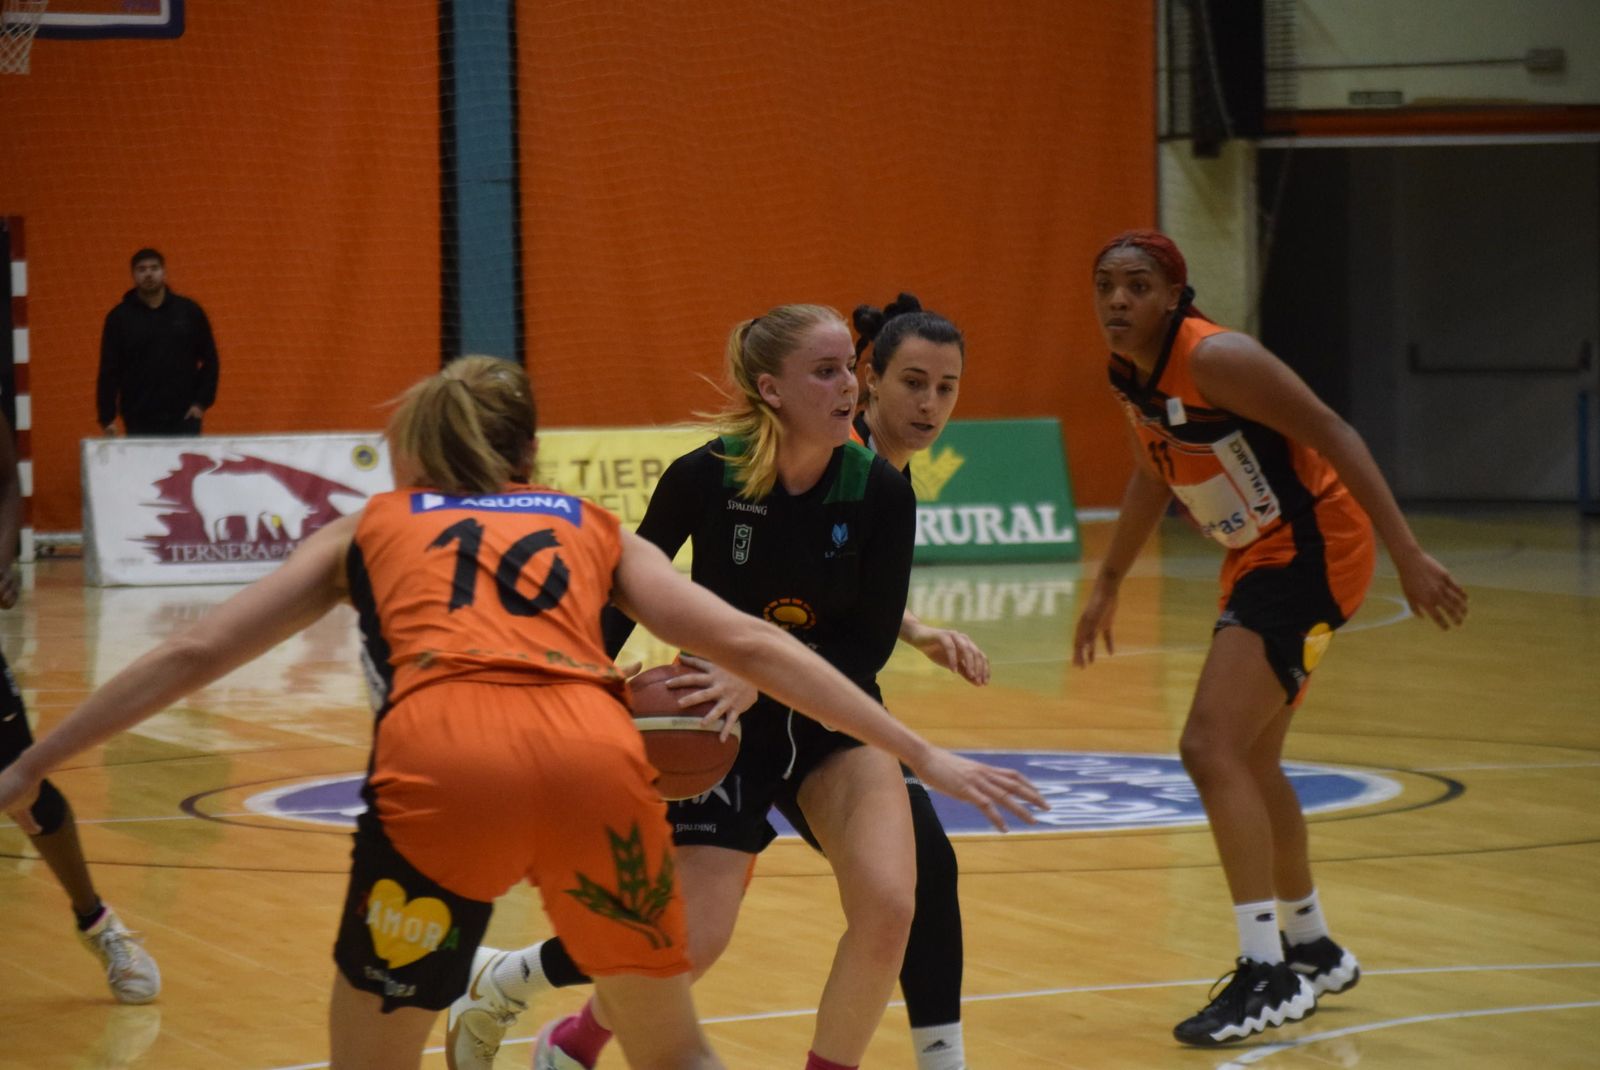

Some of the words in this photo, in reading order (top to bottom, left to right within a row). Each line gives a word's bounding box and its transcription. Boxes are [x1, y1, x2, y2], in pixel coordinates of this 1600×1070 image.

[570, 459, 673, 490] TIER
[459, 496, 572, 514] AQUONA
[726, 500, 768, 516] SPALDING
[914, 503, 1076, 546] RURAL
[165, 542, 271, 563] TERNERA
